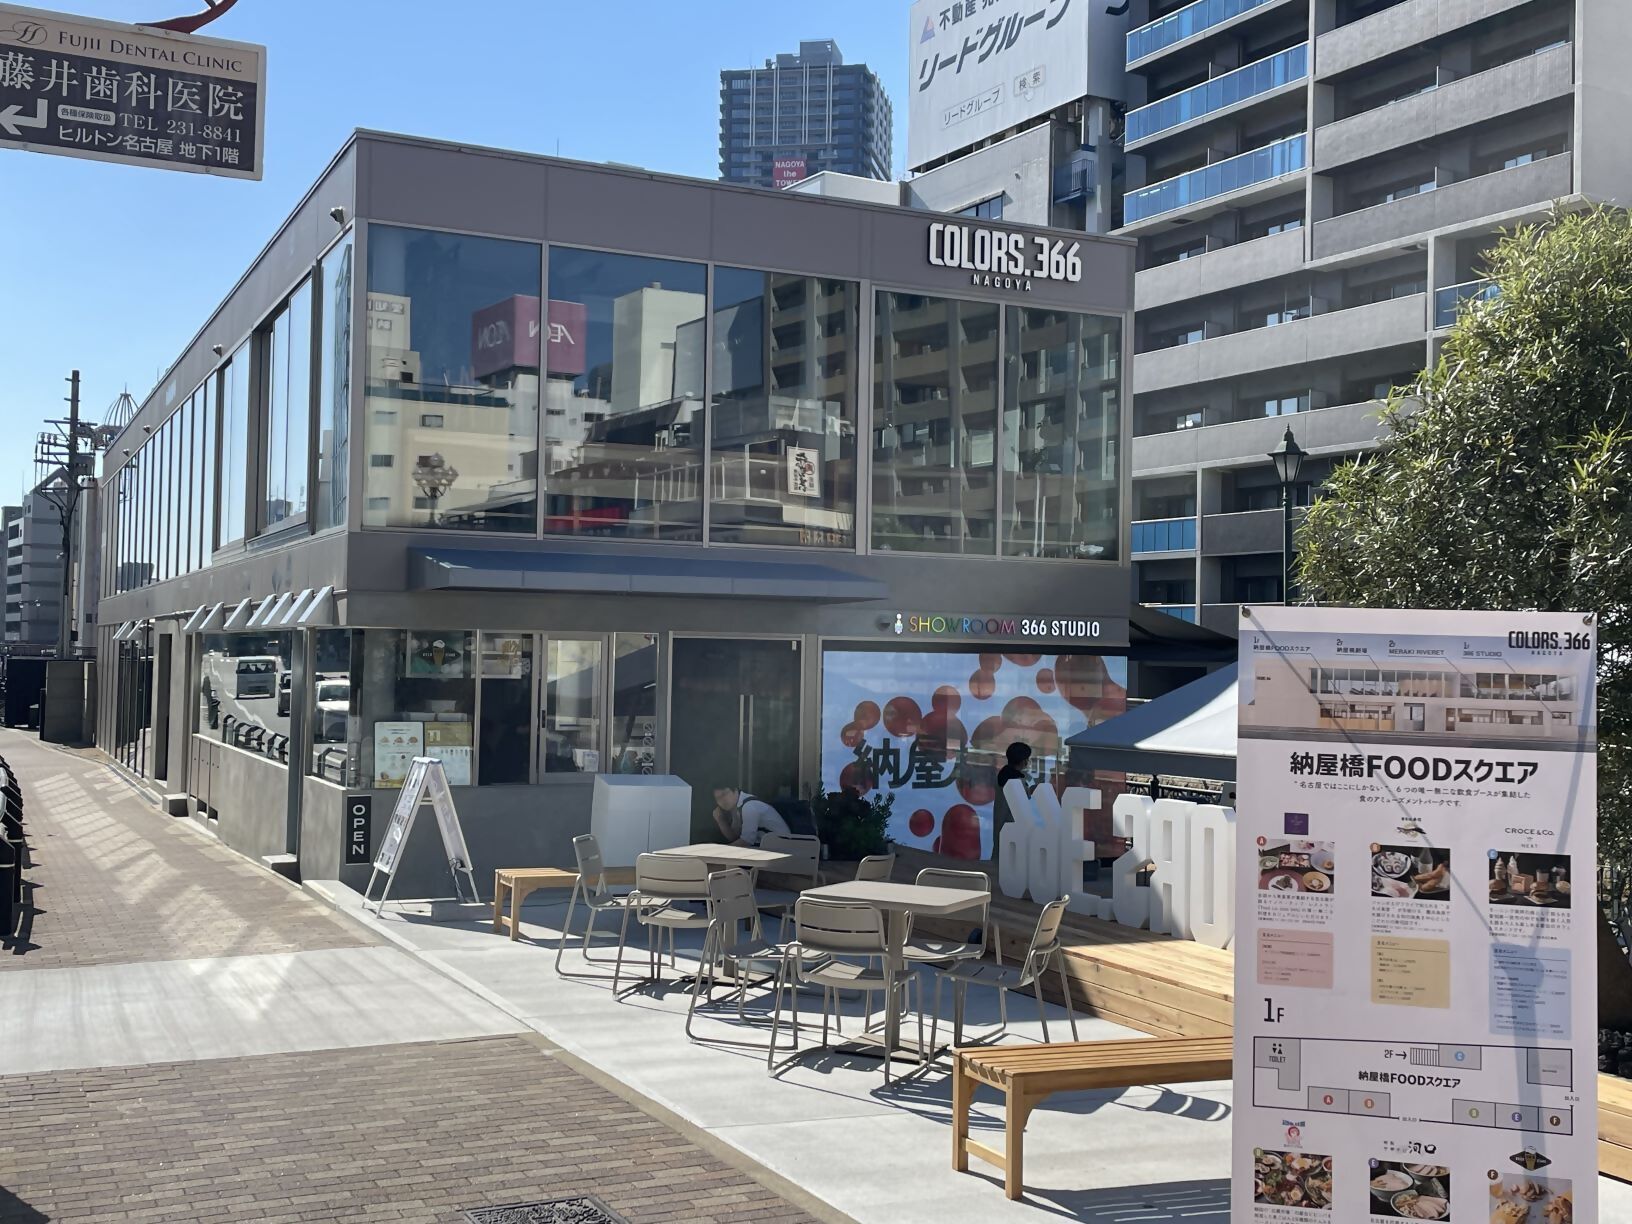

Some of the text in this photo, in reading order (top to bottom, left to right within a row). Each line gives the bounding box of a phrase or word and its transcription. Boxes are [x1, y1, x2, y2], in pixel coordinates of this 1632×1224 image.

[938, 0, 977, 31] 不動産
[58, 30, 243, 73] FUJII DENTAL CLINIC
[0, 50, 244, 121] 藤井歯科医院
[1018, 72, 1041, 90] 検索
[943, 89, 1001, 126] リードグループ
[119, 112, 242, 143] TEL 231-8841
[59, 125, 240, 165] ヒルトン名古屋 地下1階
[775, 160, 805, 168] NAGOYA
[783, 170, 797, 178] the
[929, 222, 1082, 282] COLORS.366
[973, 274, 1032, 292] NAGOYA
[908, 616, 1101, 637] SHOWROOM 366 STUDIO
[1508, 630, 1591, 650] COLORS.366
[1289, 751, 1539, 785] 納屋橋FOODスクエア
[352, 804, 366, 855] OPEN
[1263, 997, 1285, 1023] 1F
[1268, 1055, 1286, 1063] TOILET
[1384, 1049, 1394, 1059] 2F
[1358, 1070, 1461, 1088] 納屋橋FOODスクエア
